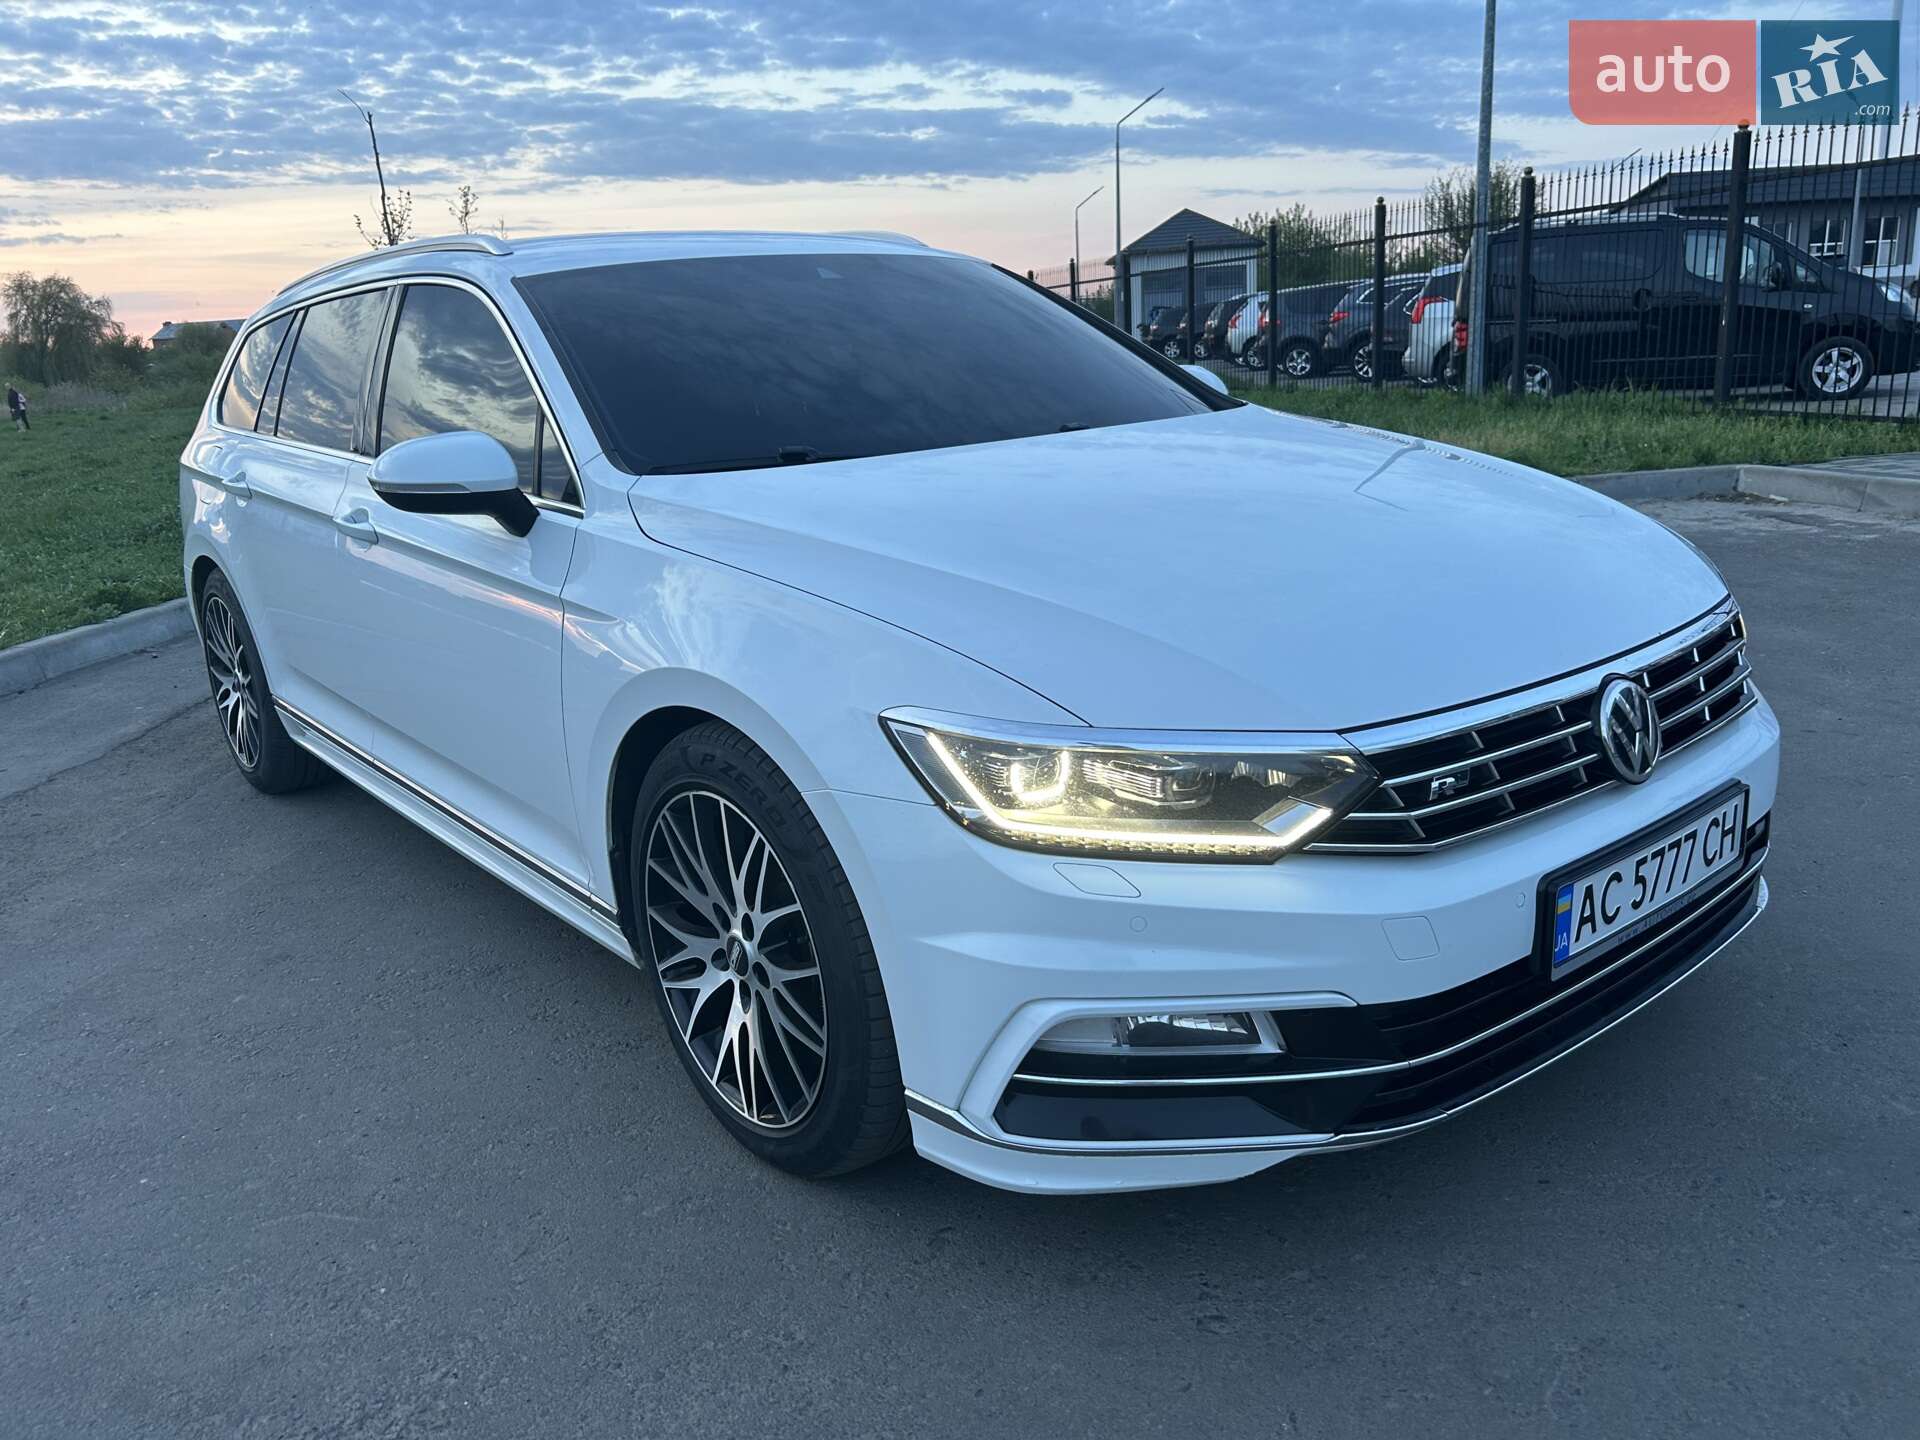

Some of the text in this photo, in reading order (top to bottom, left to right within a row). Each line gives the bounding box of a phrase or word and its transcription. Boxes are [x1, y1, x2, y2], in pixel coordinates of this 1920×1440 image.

[1574, 871, 1623, 943] AC
[1630, 828, 1698, 911] 5777
[1702, 803, 1739, 868] CH
